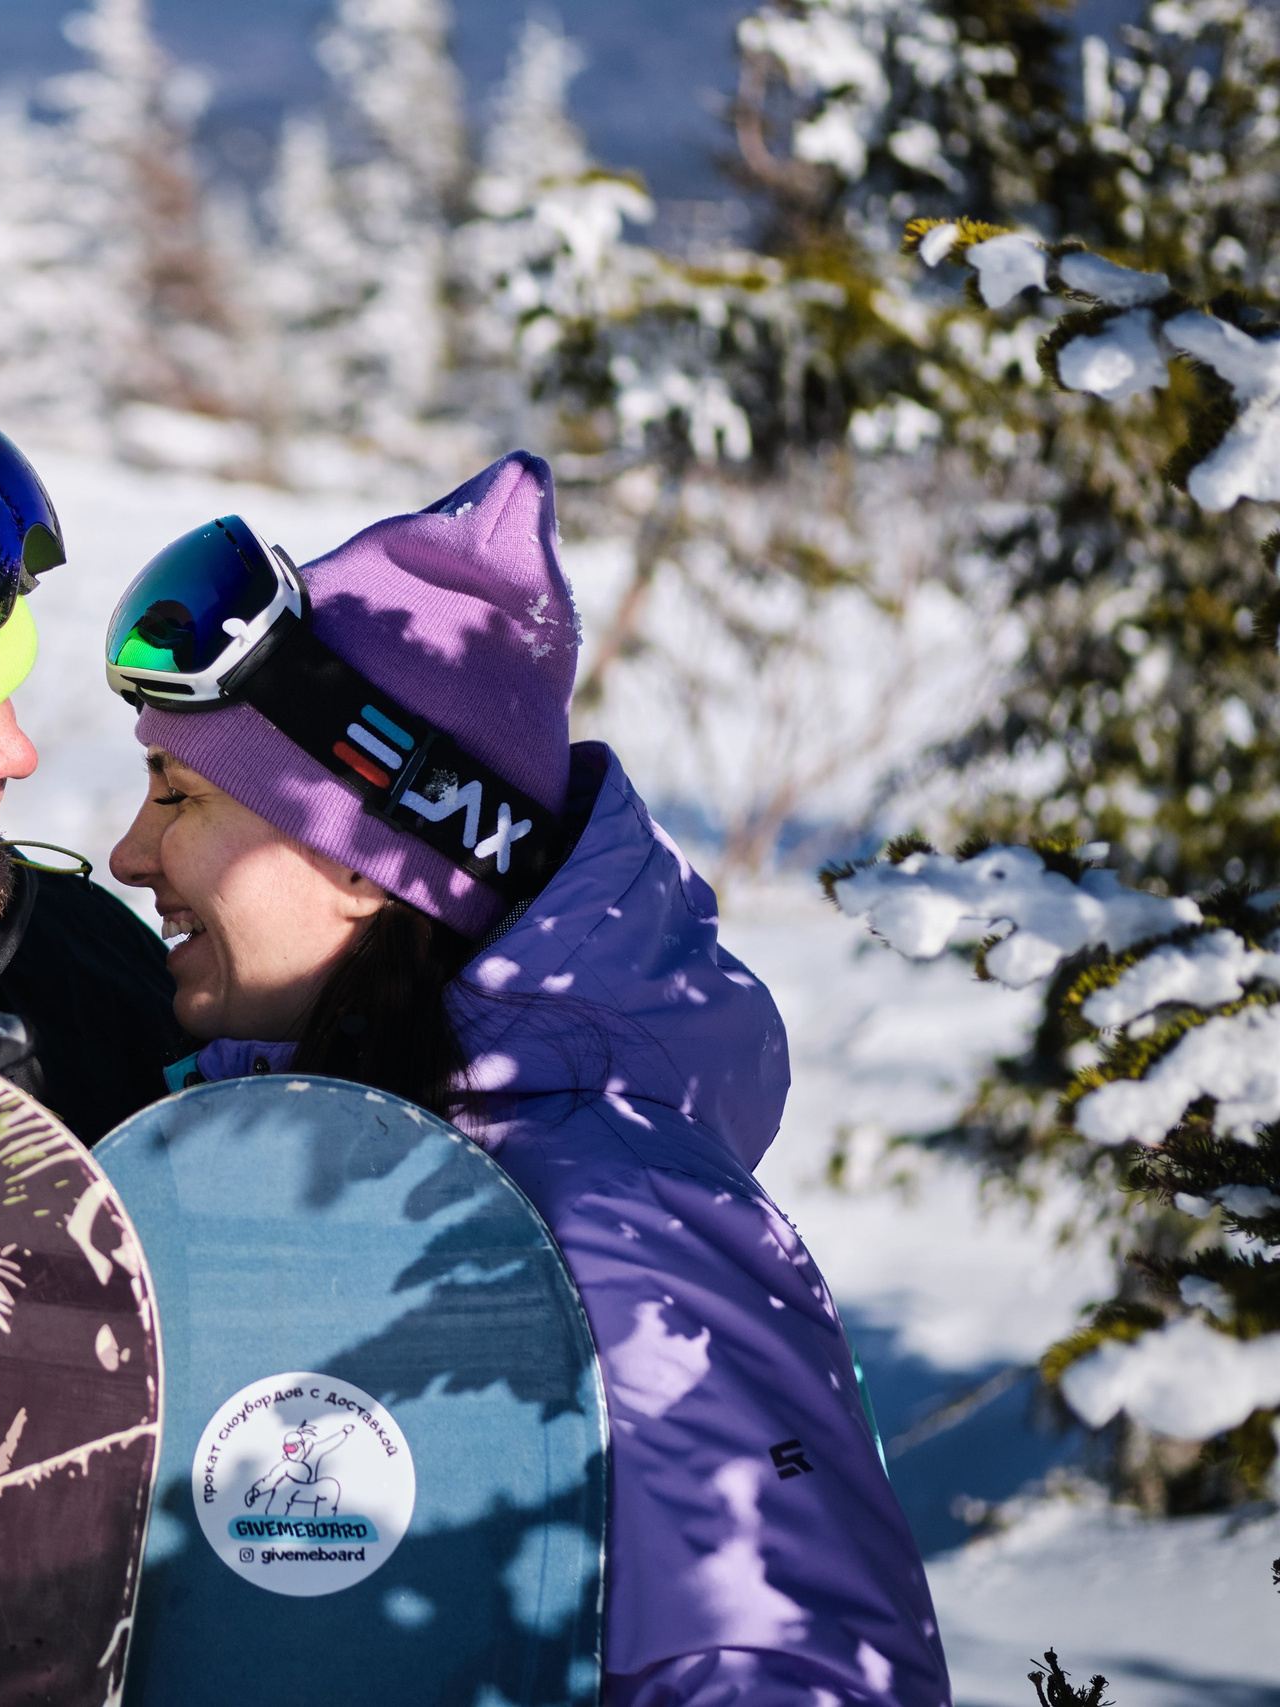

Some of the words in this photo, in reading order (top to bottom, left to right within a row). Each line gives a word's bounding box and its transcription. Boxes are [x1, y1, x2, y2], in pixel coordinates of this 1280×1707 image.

[204, 1444, 222, 1504] прокат
[218, 1387, 304, 1441] сноубордов
[310, 1388, 321, 1399] с
[324, 1391, 398, 1458] доставкой
[235, 1520, 368, 1539] GIVEMEBOARD
[261, 1547, 365, 1565] givemeboard
